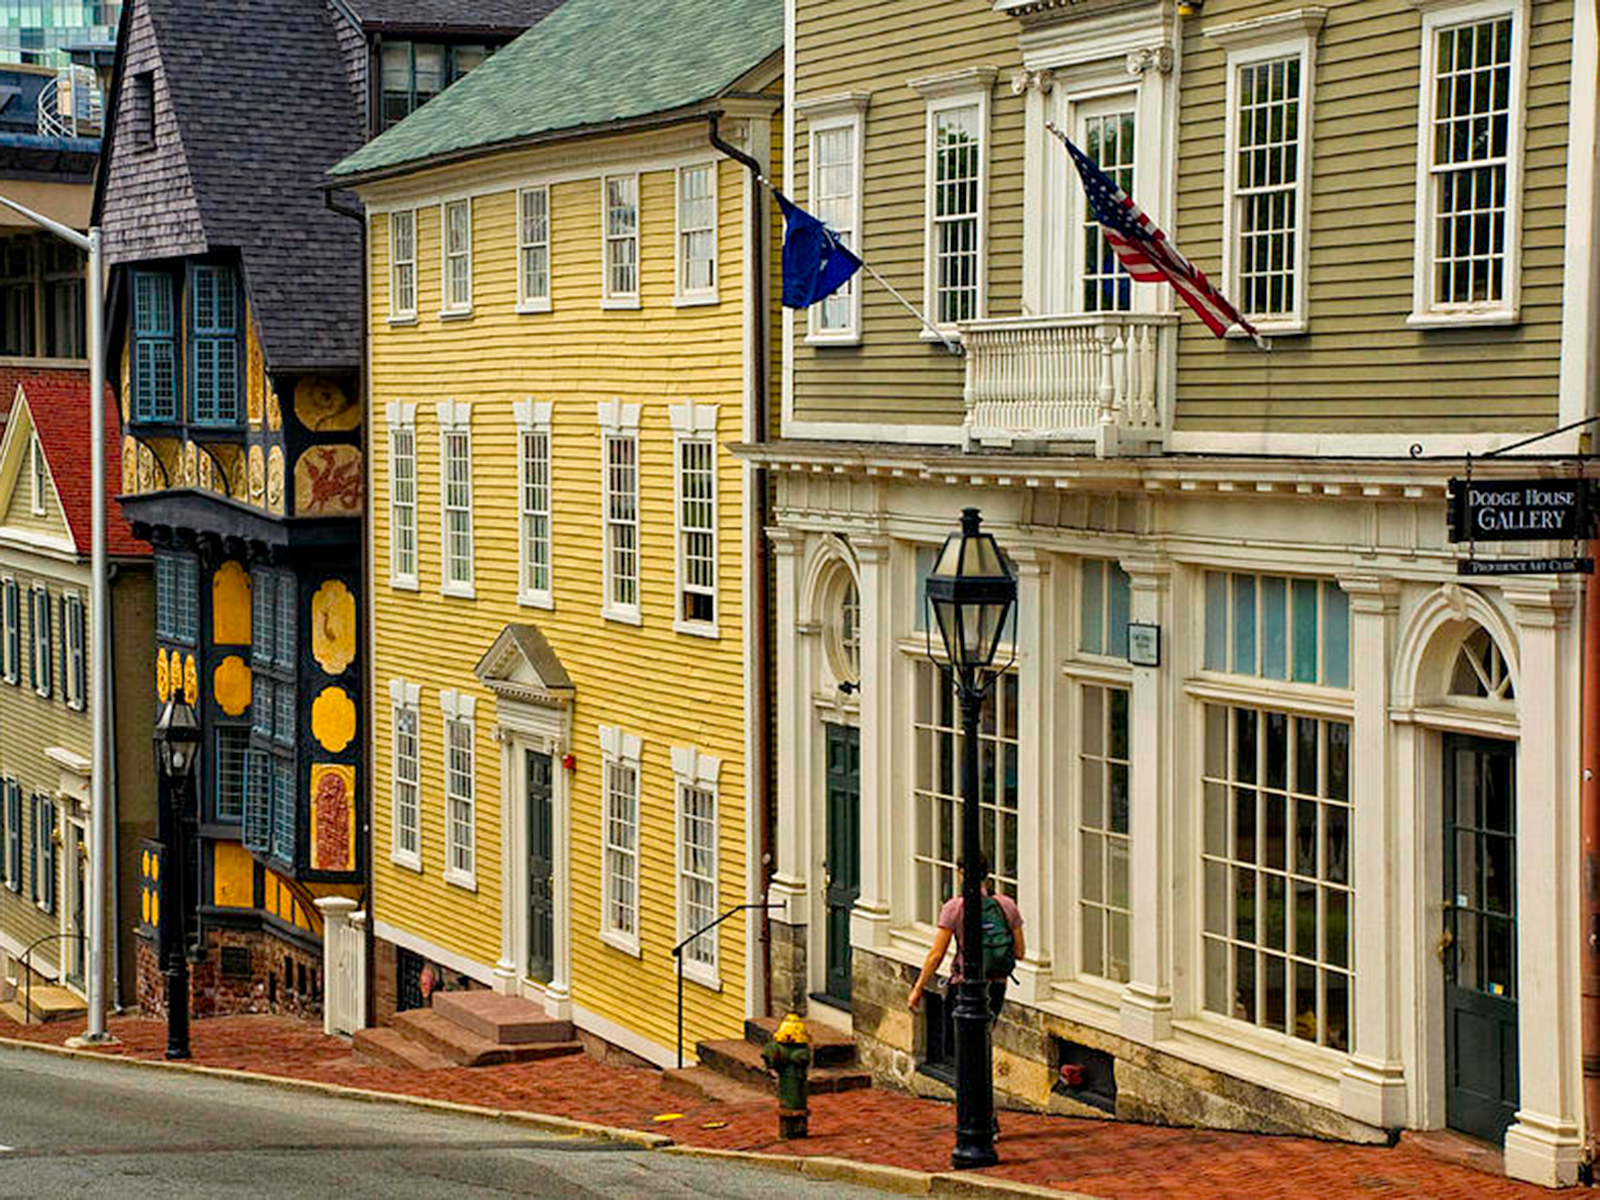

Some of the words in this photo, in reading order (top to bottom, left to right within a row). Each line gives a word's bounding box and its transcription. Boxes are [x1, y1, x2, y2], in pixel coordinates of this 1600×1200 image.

[1468, 490, 1521, 506] DODGE
[1525, 489, 1575, 506] HOUSE
[1478, 507, 1565, 530] GALLERY
